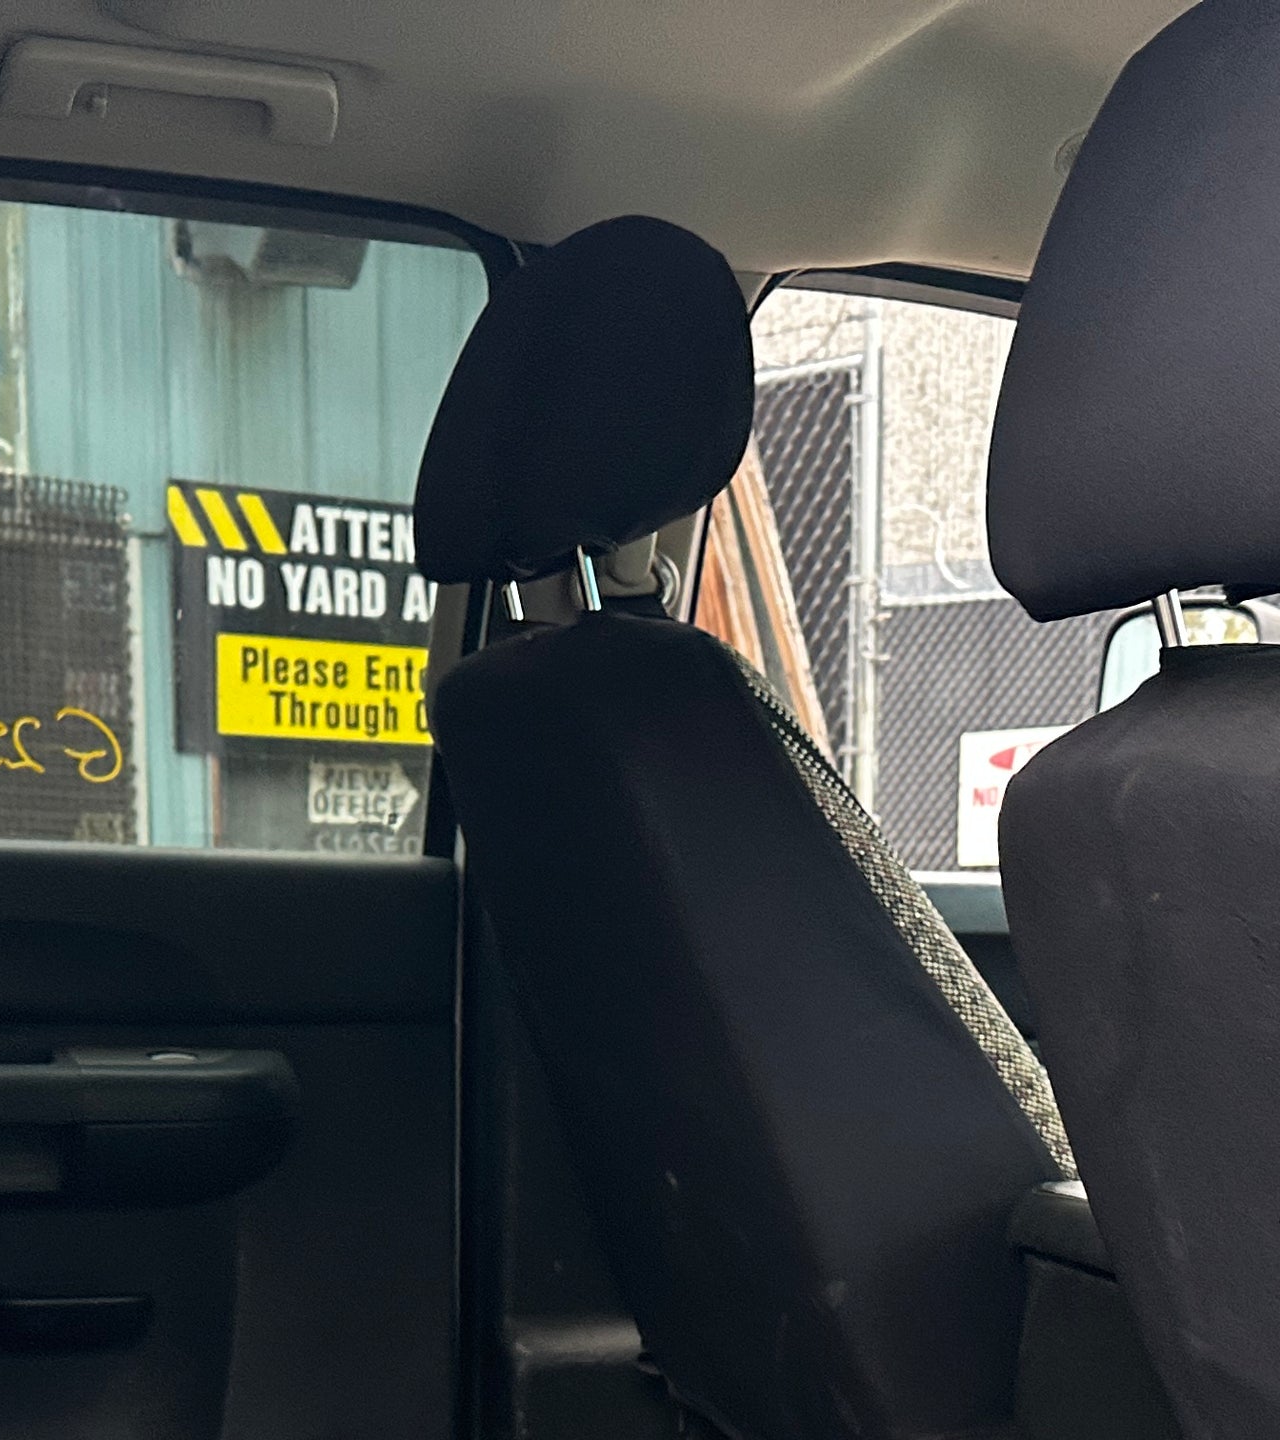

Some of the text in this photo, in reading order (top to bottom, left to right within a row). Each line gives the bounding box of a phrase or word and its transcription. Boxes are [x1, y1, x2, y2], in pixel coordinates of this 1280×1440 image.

[290, 503, 415, 565] ATTEN
[206, 556, 265, 608] NO
[281, 562, 386, 618] YARD
[241, 647, 348, 688] Please
[270, 690, 398, 737] Through
[314, 789, 404, 819] OFFICE
